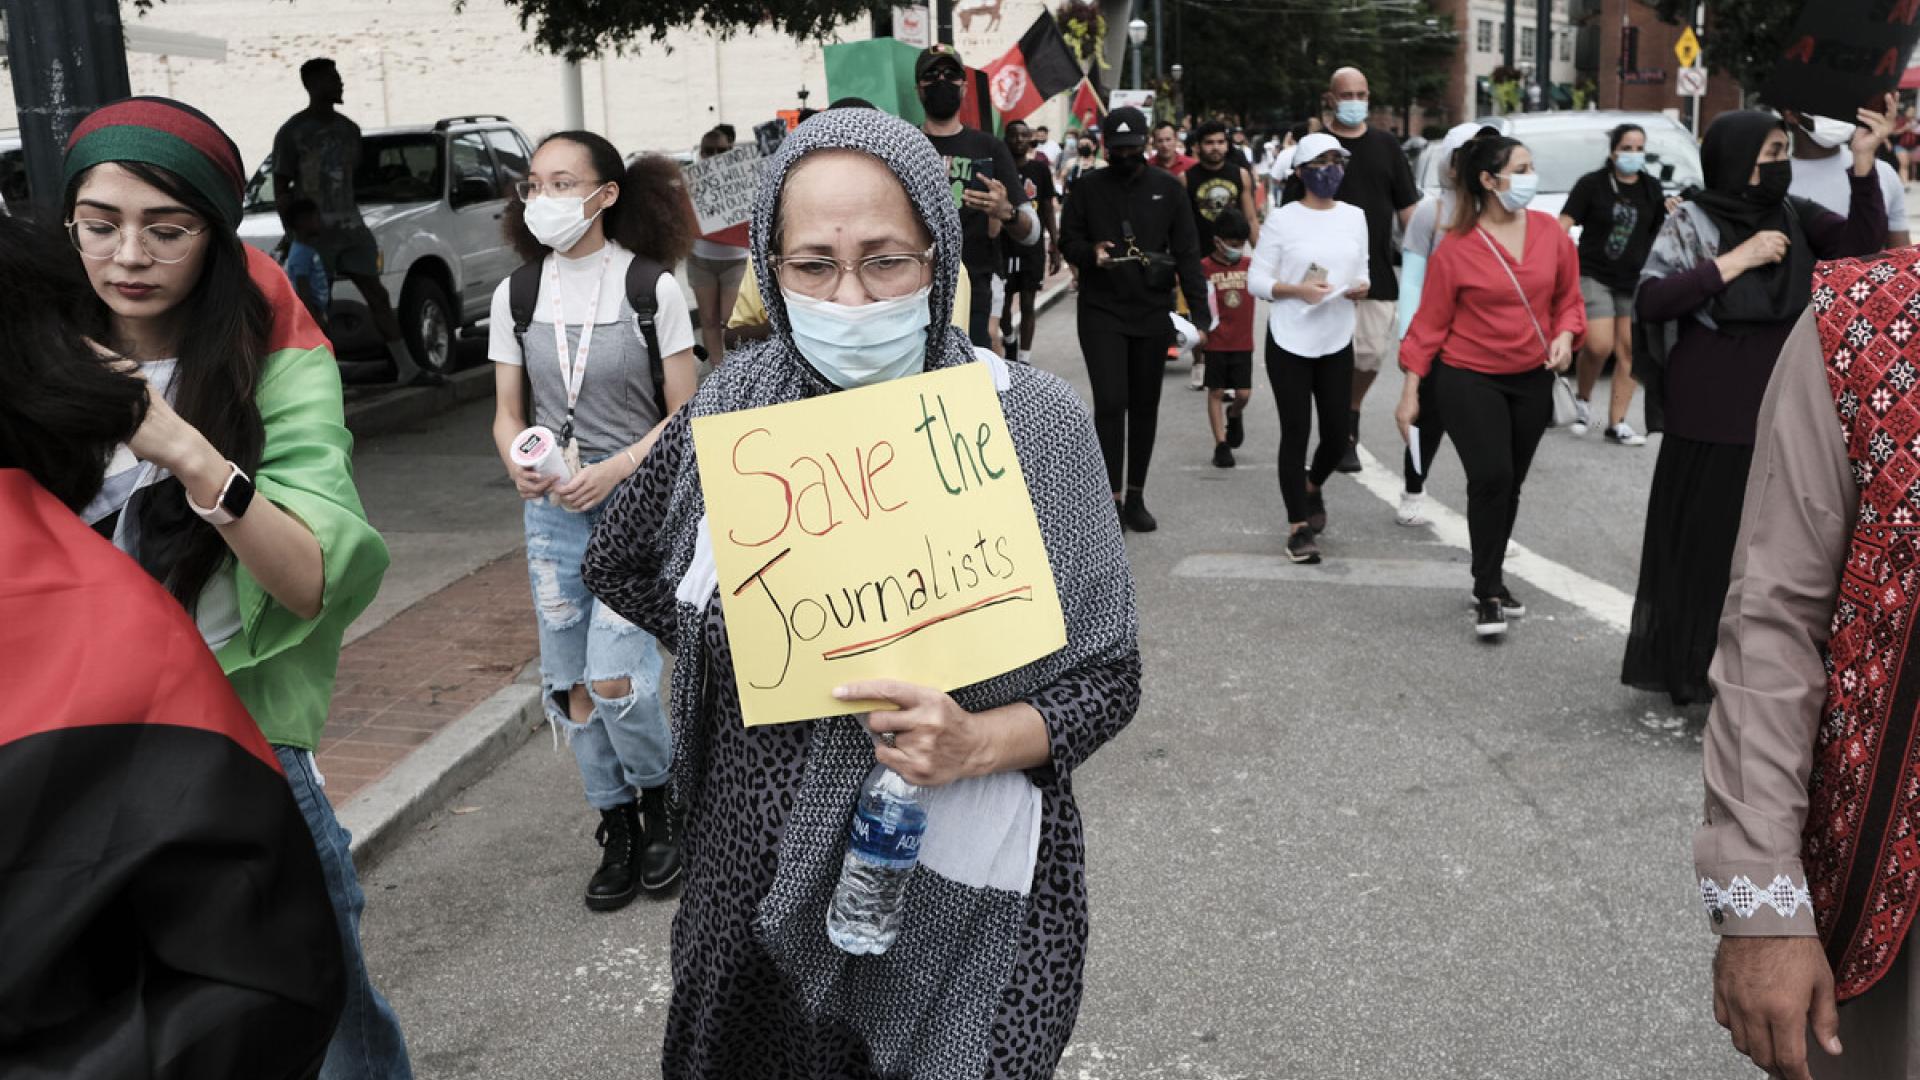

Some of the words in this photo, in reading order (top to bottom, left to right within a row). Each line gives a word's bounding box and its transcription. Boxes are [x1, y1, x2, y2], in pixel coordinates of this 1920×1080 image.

[1208, 270, 1248, 284] ATLANT
[729, 427, 908, 547] Save
[914, 393, 1006, 495] the
[733, 529, 1015, 689] Journalists
